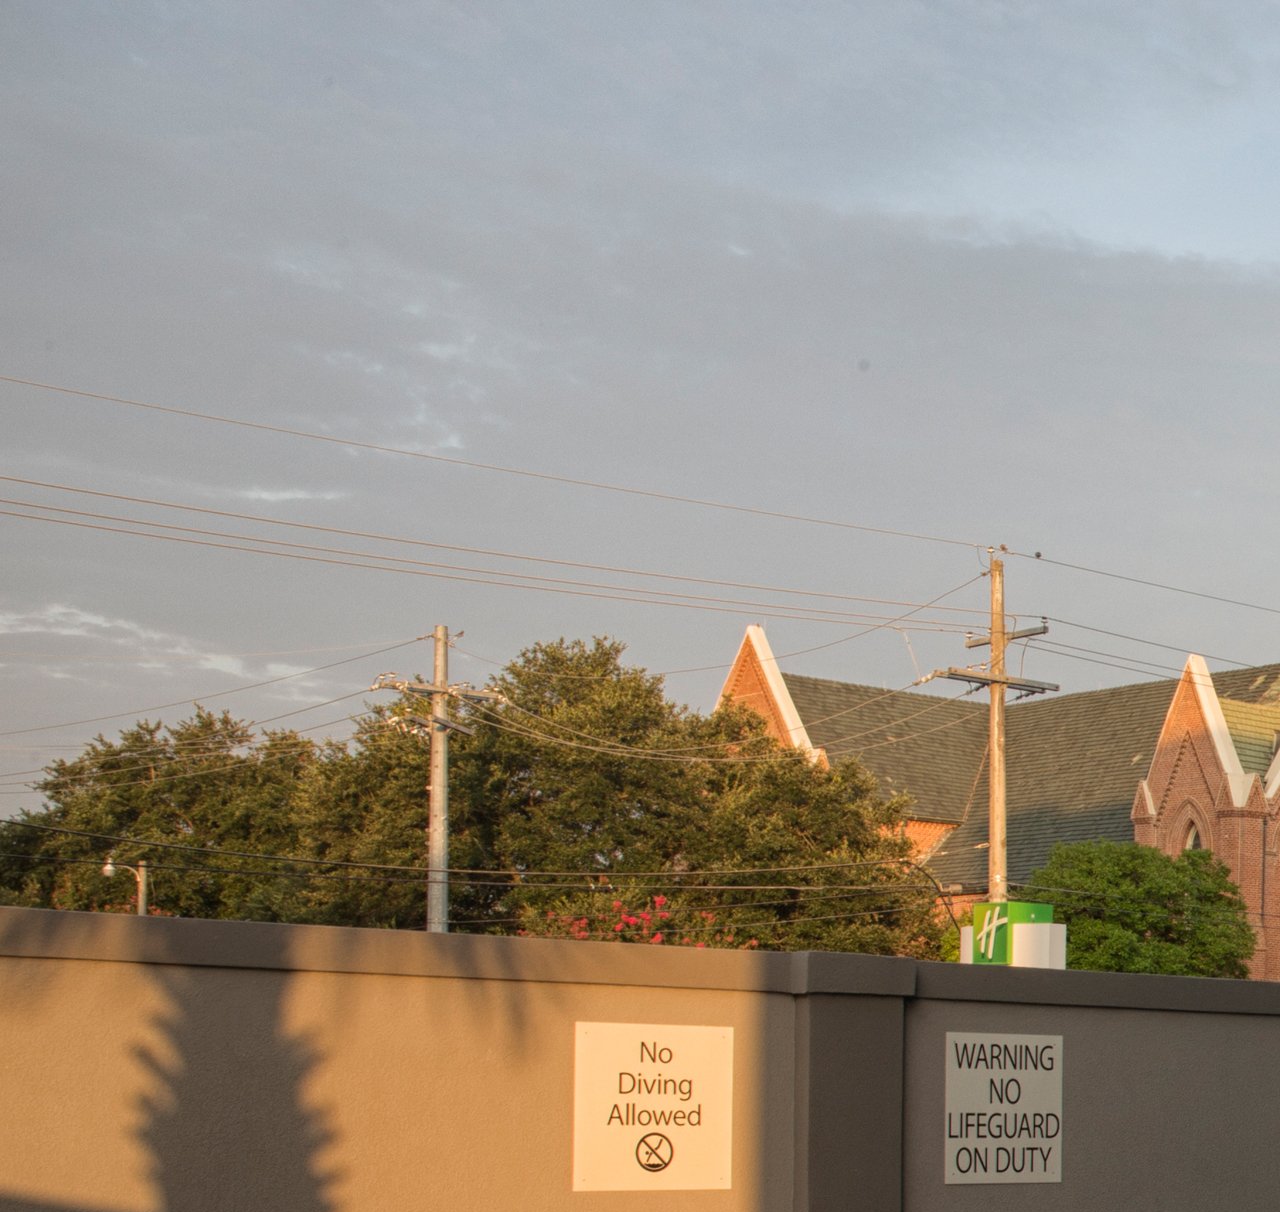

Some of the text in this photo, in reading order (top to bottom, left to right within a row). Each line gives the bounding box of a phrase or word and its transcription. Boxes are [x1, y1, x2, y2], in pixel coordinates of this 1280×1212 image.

[640, 1041, 673, 1064] No
[955, 1043, 1054, 1071] WARNING
[618, 1072, 693, 1102] Diving
[990, 1078, 1021, 1104] NO
[607, 1102, 702, 1126] Allowed
[948, 1112, 1060, 1139] LIFEGUARD
[956, 1147, 1052, 1174] ON DUTY
